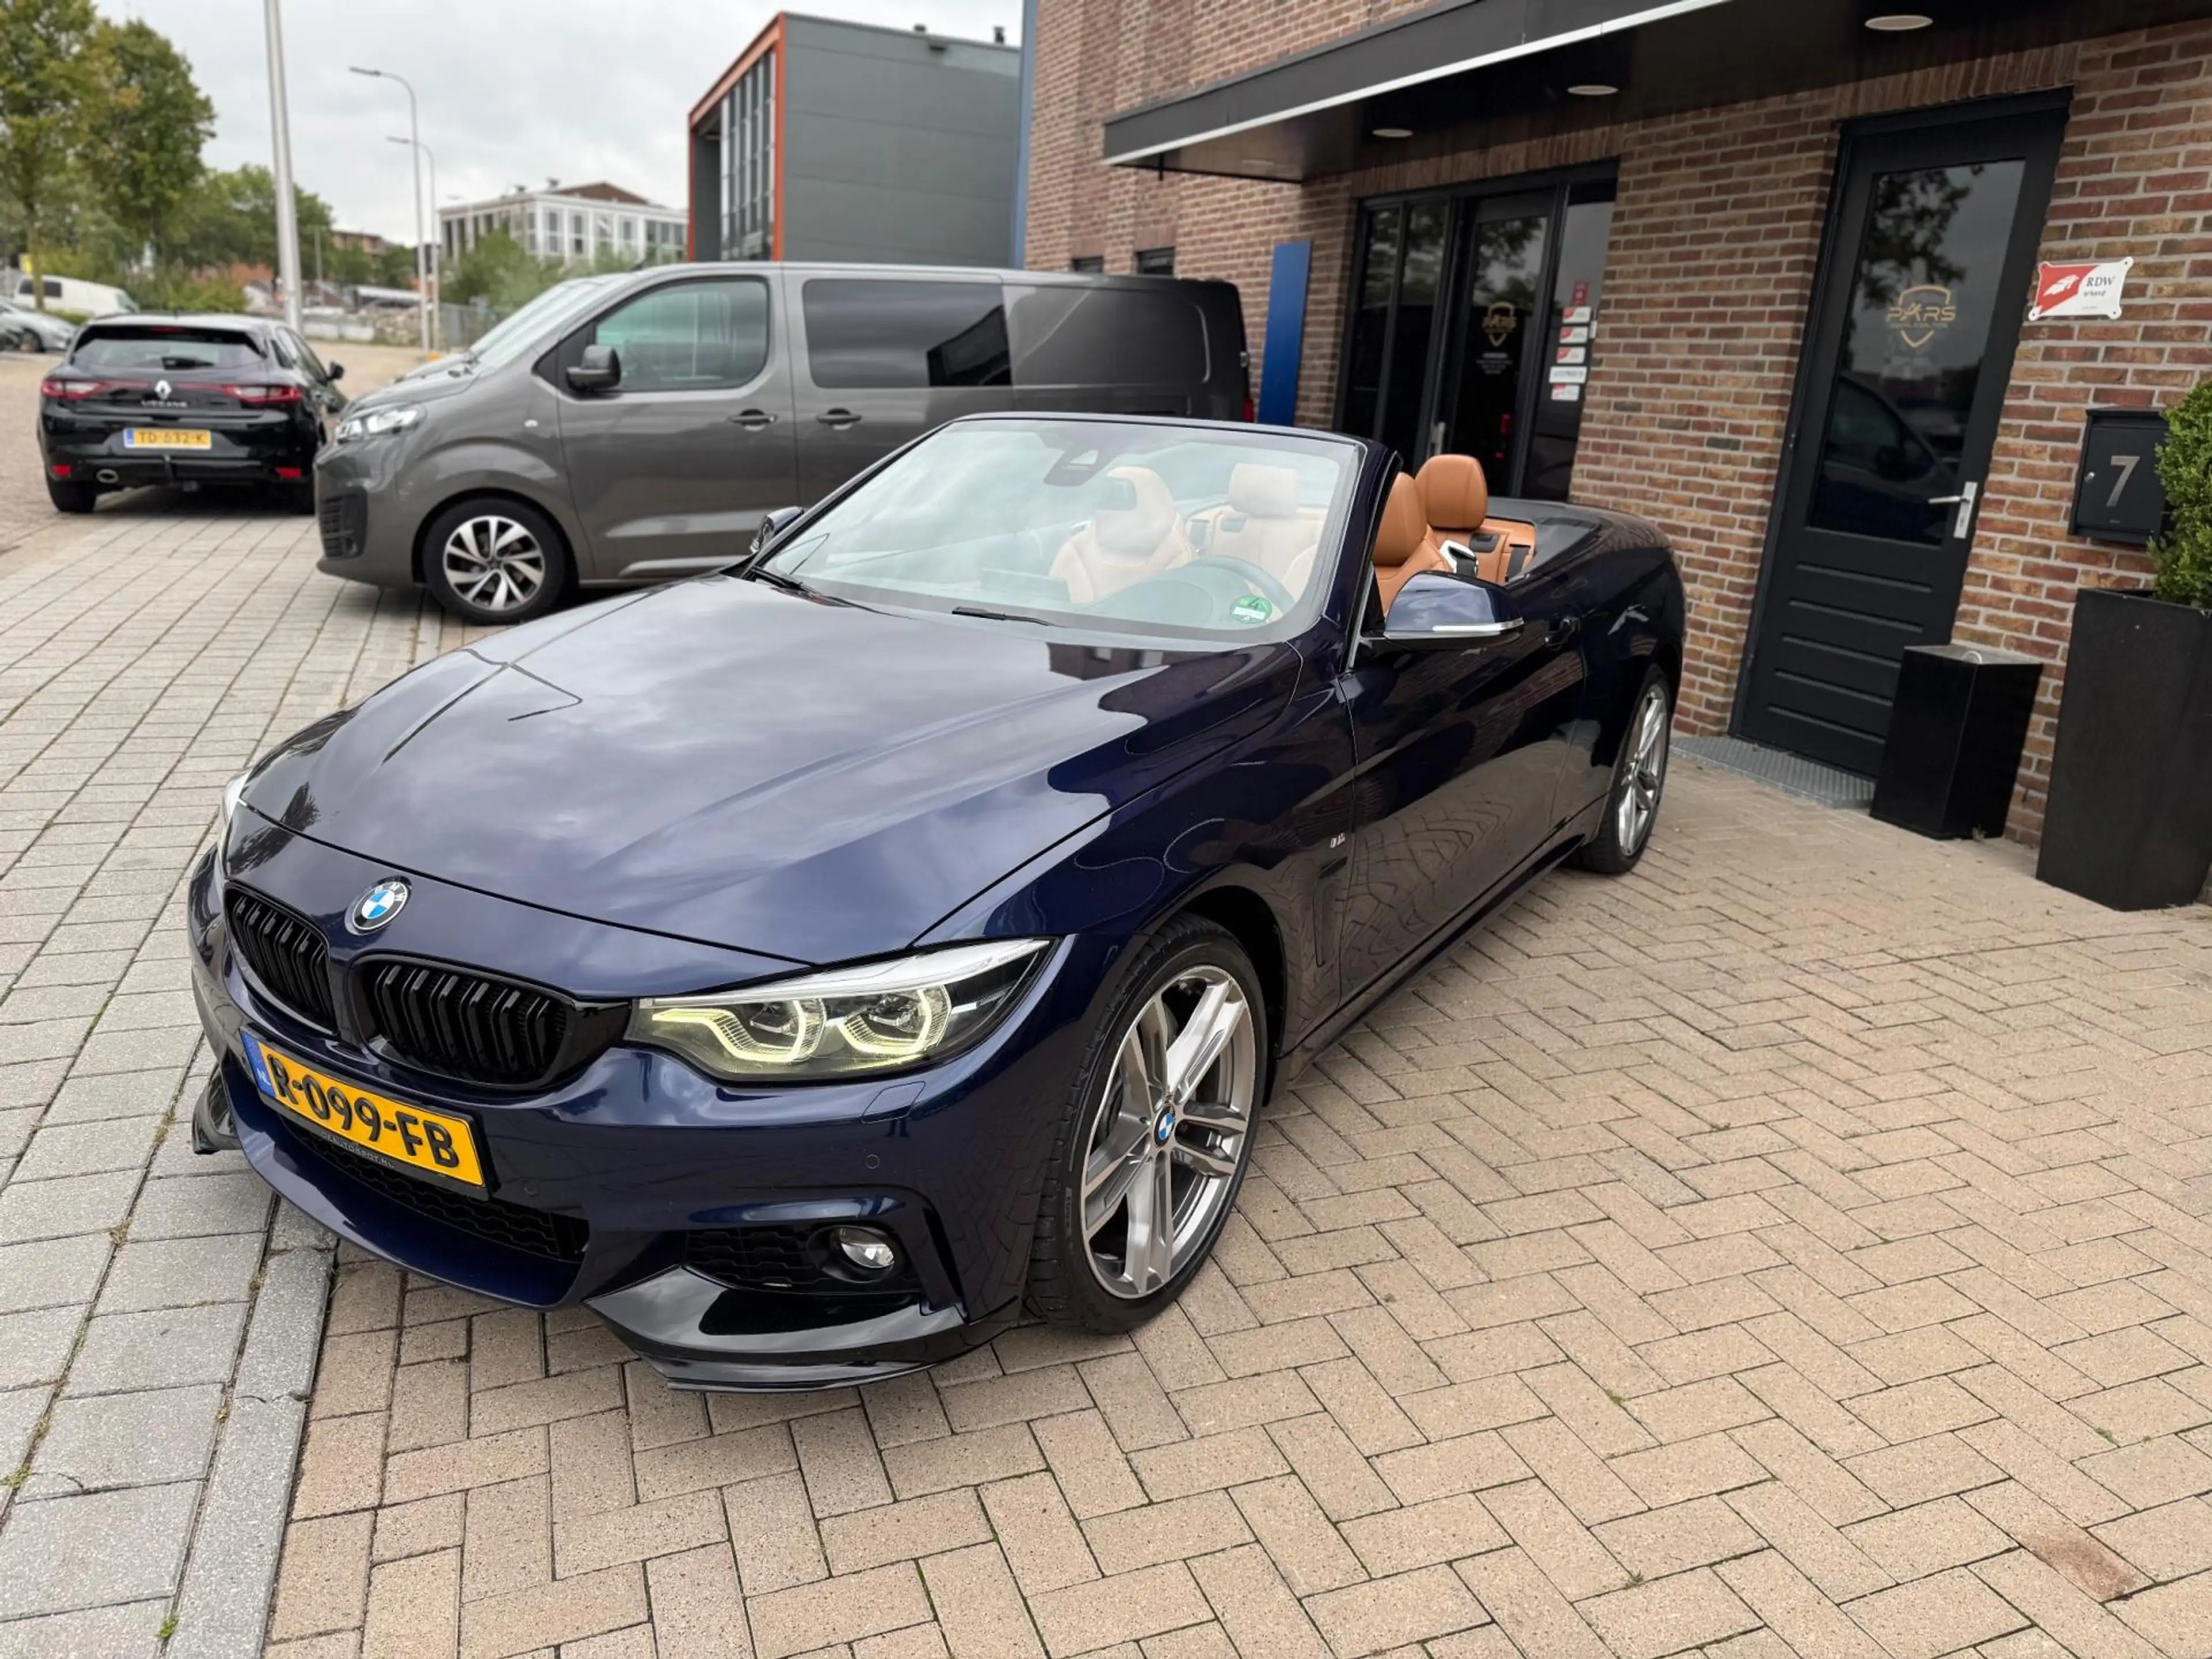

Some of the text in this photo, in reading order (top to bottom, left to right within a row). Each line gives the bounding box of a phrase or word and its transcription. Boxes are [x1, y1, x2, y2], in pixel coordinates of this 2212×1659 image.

[2086, 276, 2115, 287] RDW
[1885, 302, 1956, 322] PARS
[2106, 455, 2141, 507] 7
[256, 1067, 271, 1086] NL
[267, 1054, 459, 1168] R-099-FB
